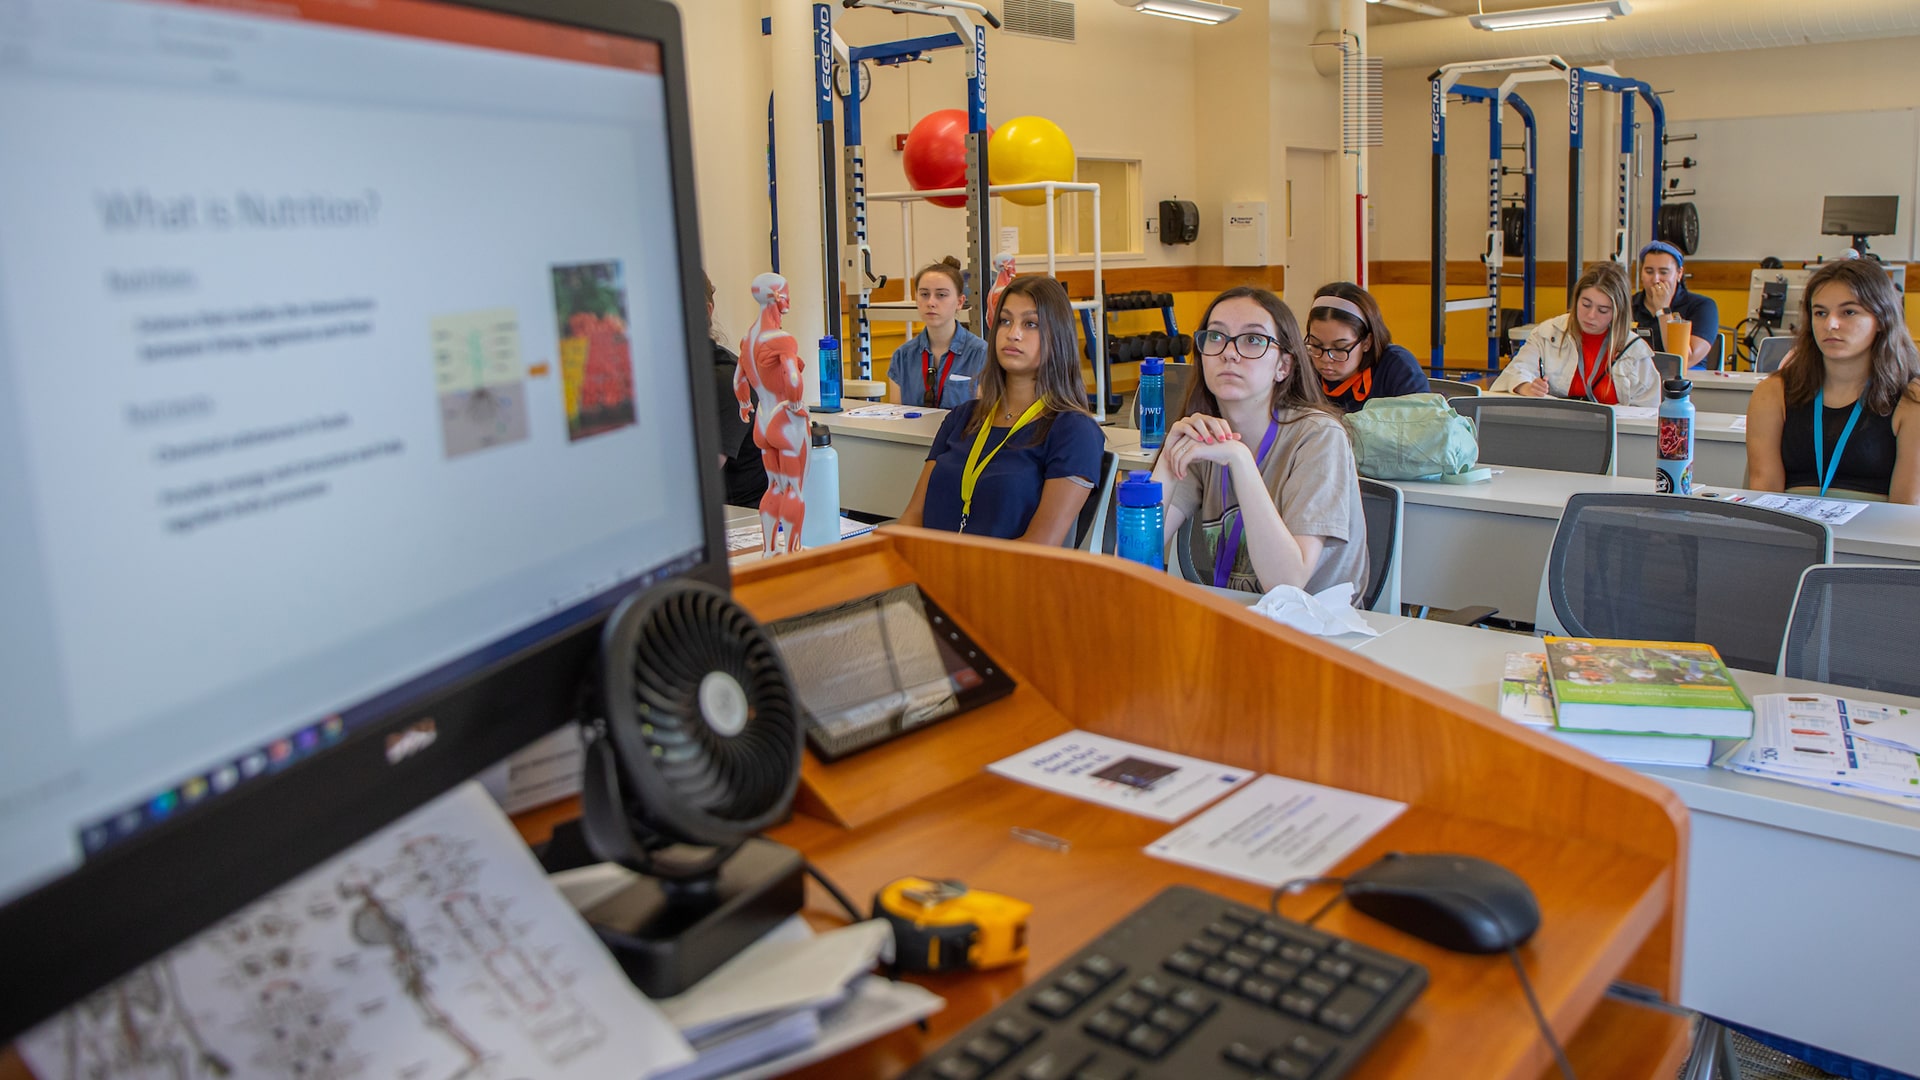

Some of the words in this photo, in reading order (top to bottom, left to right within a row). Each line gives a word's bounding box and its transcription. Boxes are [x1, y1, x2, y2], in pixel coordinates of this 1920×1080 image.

[820, 7, 832, 102] LEGEND
[977, 28, 987, 114] LEGEND
[1570, 69, 1579, 134] LEGEND
[1144, 407, 1161, 416] JWU
